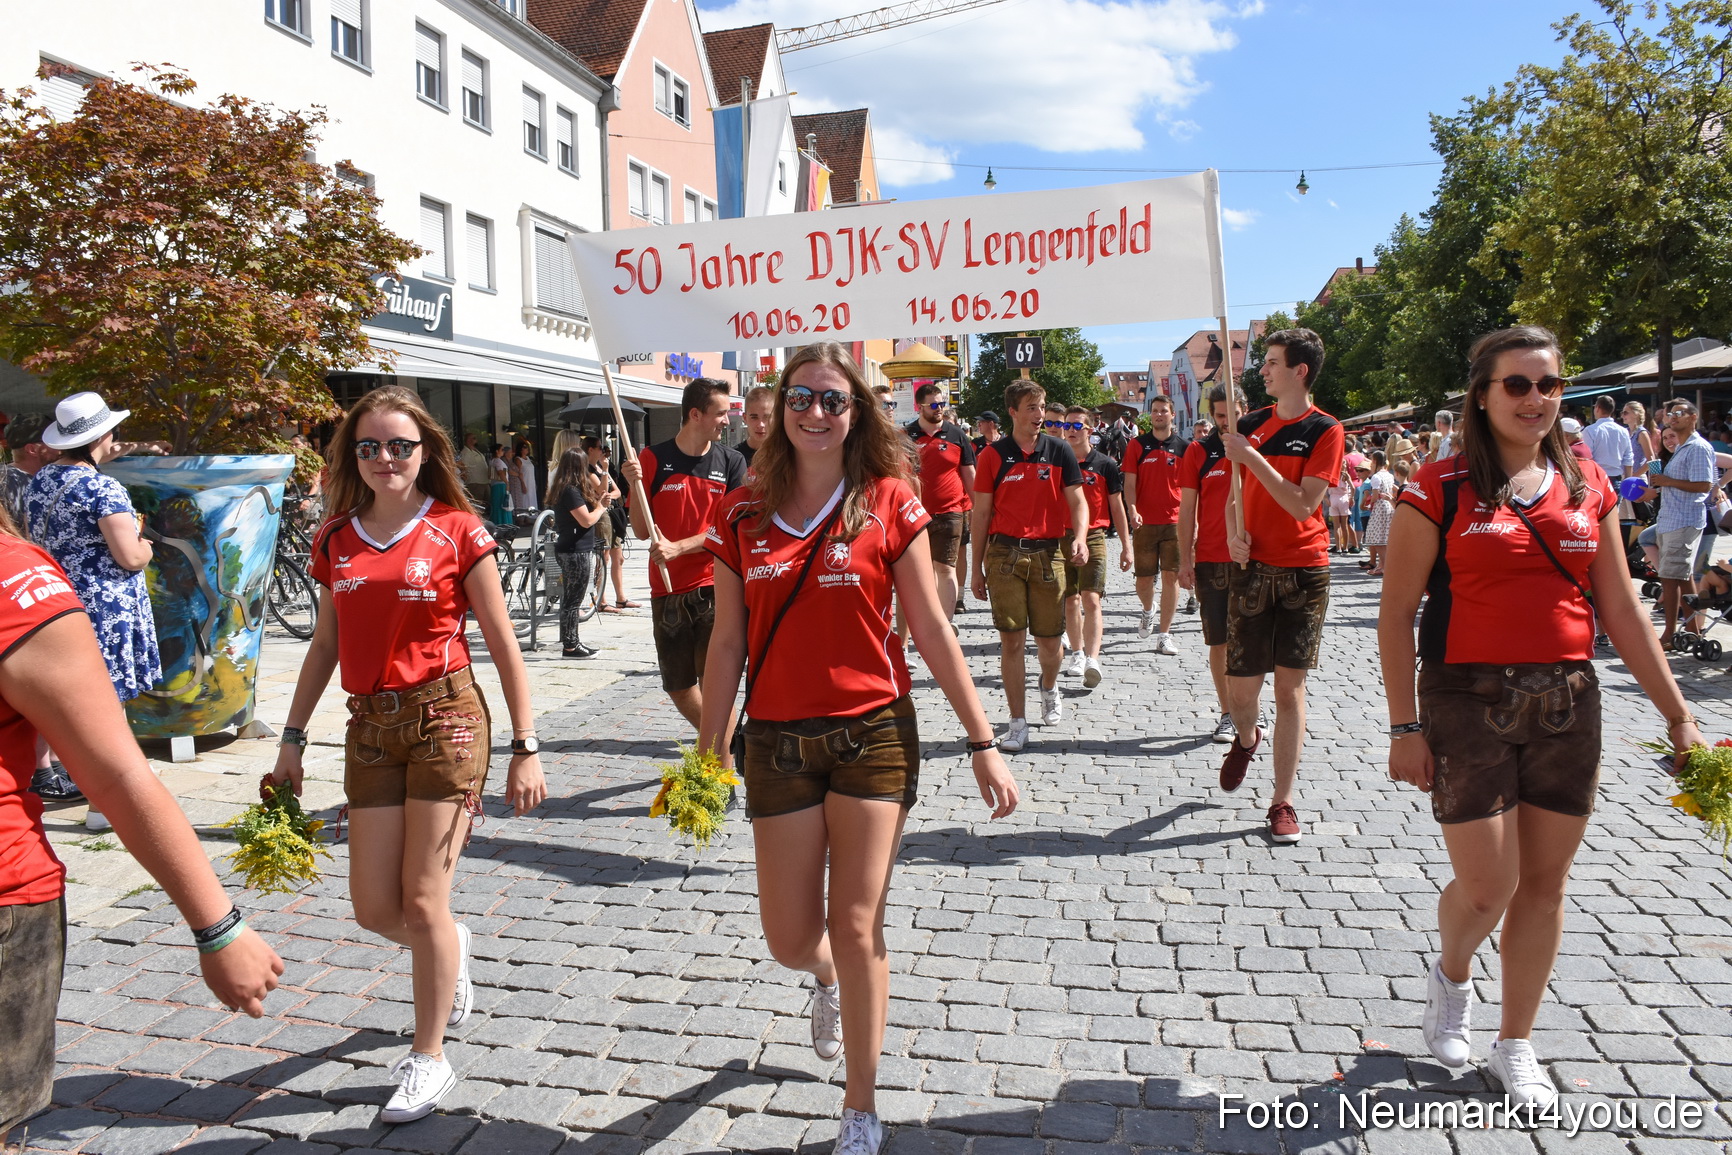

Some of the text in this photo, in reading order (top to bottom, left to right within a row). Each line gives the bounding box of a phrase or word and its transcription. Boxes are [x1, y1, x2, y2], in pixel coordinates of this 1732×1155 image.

[613, 203, 1152, 295] 50 Jahre DJK-SV Lengenfeld
[376, 276, 451, 332] ühauf
[727, 288, 1040, 339] 10.06.20 14.06.20
[1015, 343, 1034, 362] 69
[946, 342, 959, 405] HOEL
[424, 529, 448, 547] Franzi
[1460, 523, 1502, 536] JURA
[1560, 540, 1587, 548] Winkler
[746, 564, 775, 583] JURA
[818, 574, 843, 584] Winkler
[844, 572, 861, 582] Bräu
[398, 589, 422, 597] Winkler
